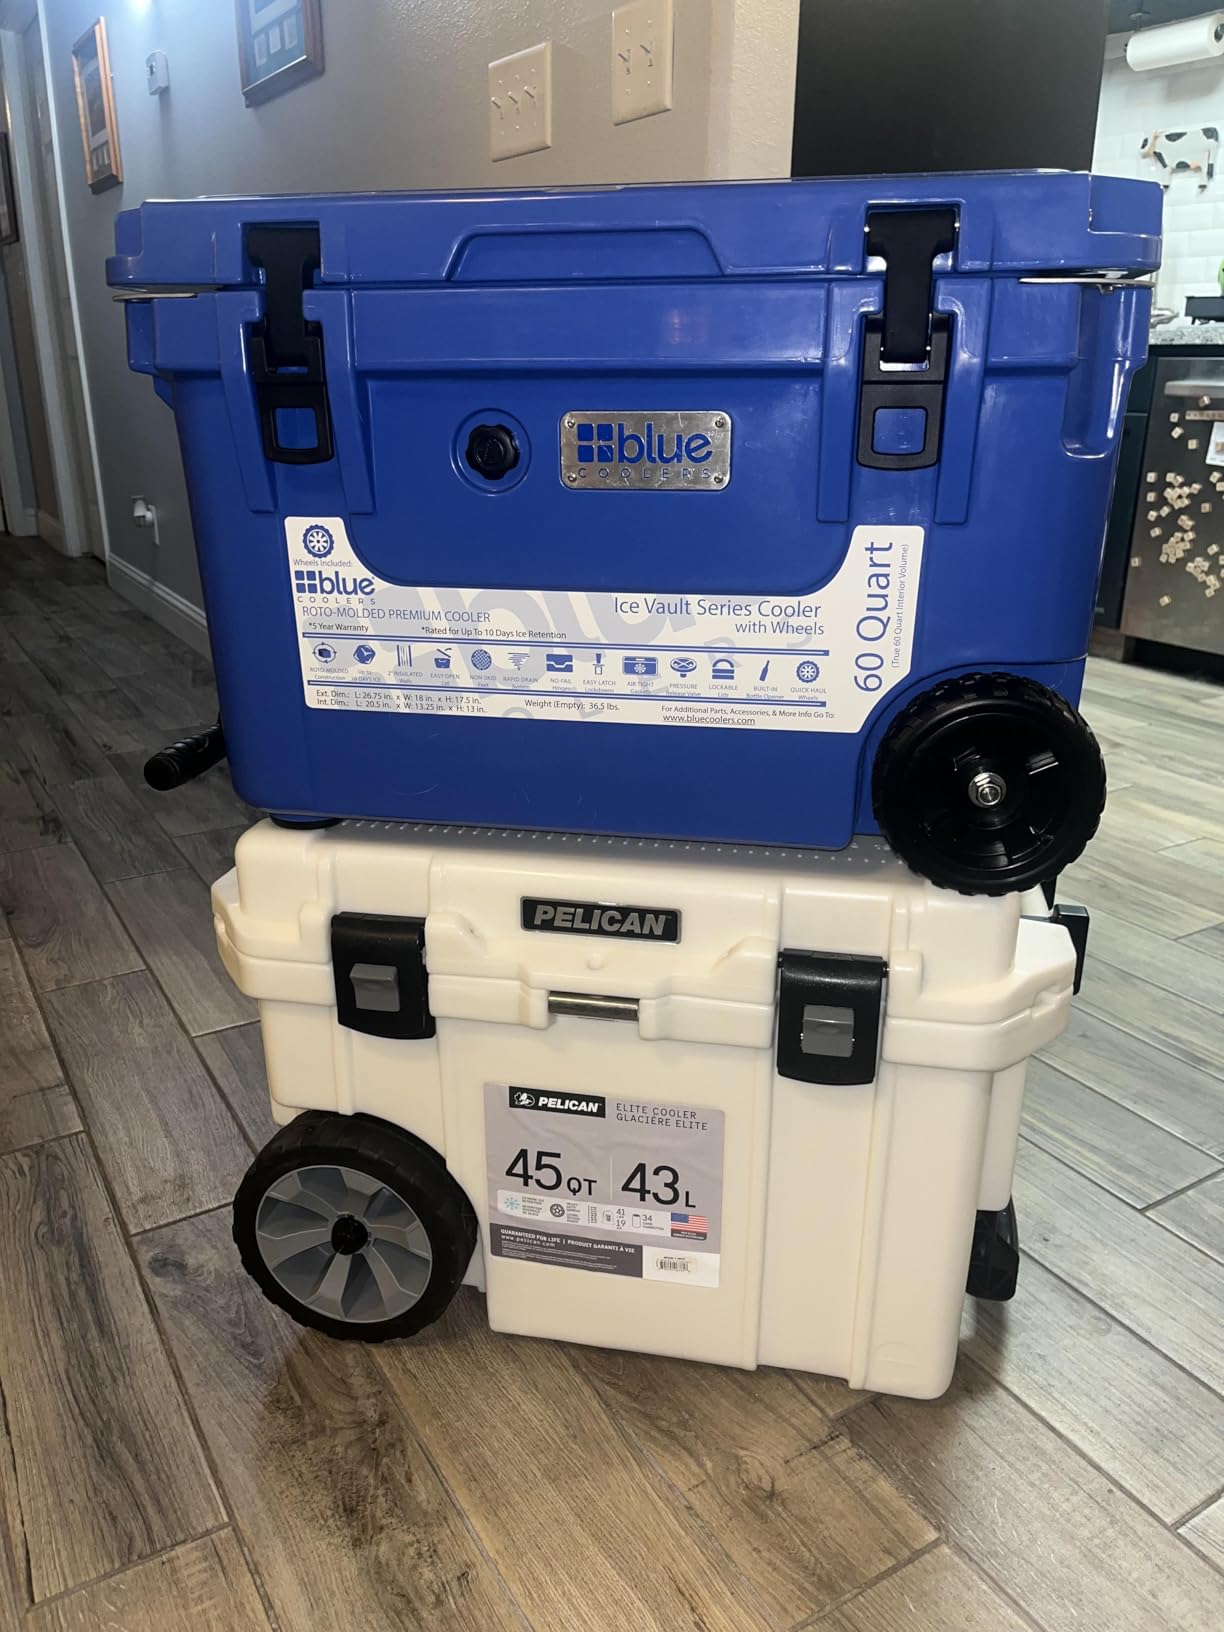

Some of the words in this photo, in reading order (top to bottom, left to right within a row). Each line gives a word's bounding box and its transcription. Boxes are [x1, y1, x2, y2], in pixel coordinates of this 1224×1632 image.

[617, 422, 713, 464] blue
[578, 467, 711, 481] COOLERS
[293, 558, 319, 567] Wheels
[320, 559, 353, 568] Included:
[899, 544, 909, 580] Volume)
[318, 570, 376, 596] blue
[297, 595, 376, 605] COOLERS
[856, 542, 893, 642] Quart
[896, 581, 905, 610] Interior
[302, 606, 386, 619] ROTO-MOLDED
[388, 609, 442, 621] PREMIUM
[445, 611, 491, 623] COOLER
[614, 597, 640, 614] Ice
[643, 597, 691, 615] Vault
[697, 599, 752, 617] Series
[758, 600, 822, 618] Cooler
[318, 623, 334, 631] Year
[335, 623, 369, 632] Warranty
[735, 620, 766, 634] with
[771, 621, 825, 635] Wheels
[894, 611, 903, 635] Quart
[449, 627, 460, 636] for
[461, 628, 472, 637] Up
[474, 628, 483, 636] To
[484, 629, 494, 637] 10
[495, 629, 514, 638] Days
[515, 630, 527, 638] Ice
[528, 630, 567, 640] Retention
[894, 636, 901, 646] 60
[891, 646, 900, 668] (True
[854, 652, 884, 692] 60
[316, 689, 330, 698] Ext.
[362, 692, 382, 700] 26.75
[383, 692, 393, 701] in.
[425, 695, 435, 703] in.
[445, 695, 454, 703] H:
[455, 696, 471, 704] 17.5
[471, 697, 482, 705] in.
[524, 699, 552, 708] Weight
[553, 700, 586, 710] (Empty):
[588, 702, 605, 710] 36.5
[606, 702, 620, 711] lbs.
[366, 700, 381, 708] 20.5
[382, 701, 392, 709] in.
[416, 703, 435, 711] 13.25
[436, 704, 446, 712] in.
[466, 705, 475, 713] 13
[674, 706, 709, 714] Additional
[709, 707, 729, 715] Parts,
[729, 708, 770, 717] Accessories,
[813, 711, 824, 719] Go
[825, 711, 836, 719] To:
[663, 714, 756, 726] www.bluecoolers.com
[533, 904, 666, 936] PELICAN
[538, 1096, 600, 1113] PELICAN
[616, 1103, 648, 1114] ELITE
[652, 1107, 697, 1119] COOLER
[616, 1112, 671, 1127] GLACIÈRE
[675, 1119, 708, 1131] ELITE
[505, 1148, 563, 1191] 45
[566, 1176, 598, 1196] QT
[621, 1162, 680, 1206] 43
[685, 1190, 697, 1209] L
[616, 1208, 626, 1216] 41
[642, 1214, 653, 1222] 34
[616, 1219, 626, 1227] 19
[501, 1235, 556, 1247] www.pelican.com
[567, 1239, 592, 1248] PRODUIT
[593, 1242, 619, 1251] GARANTI
